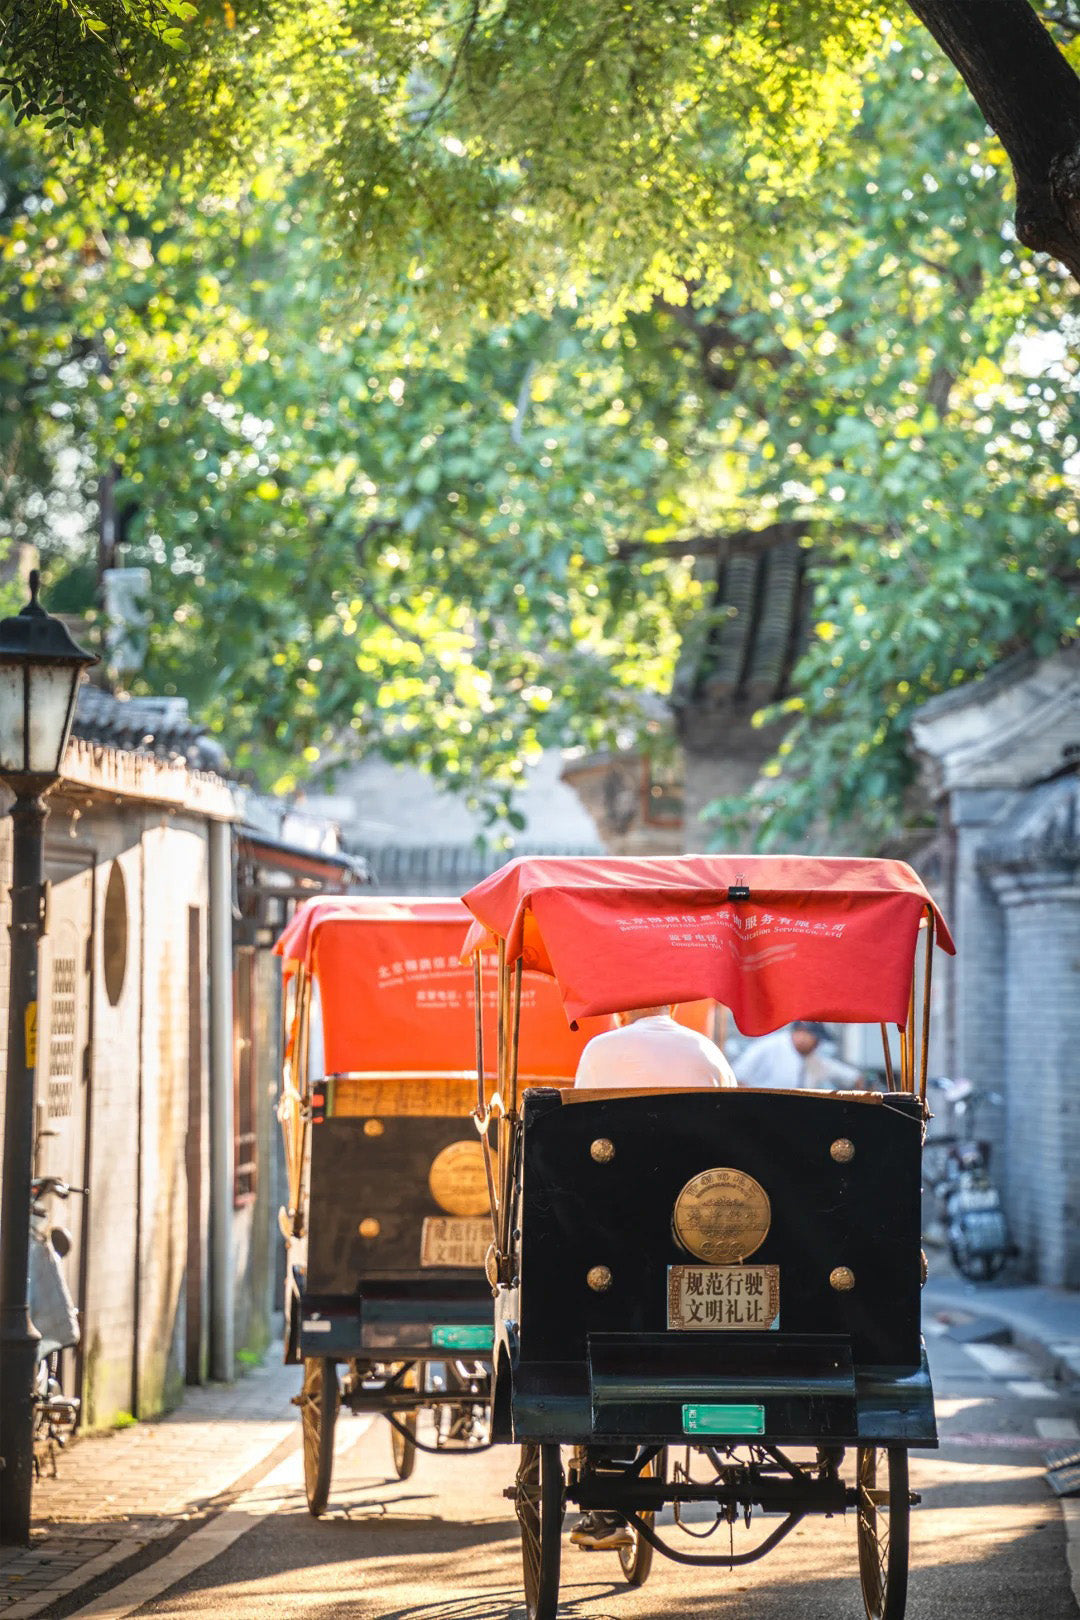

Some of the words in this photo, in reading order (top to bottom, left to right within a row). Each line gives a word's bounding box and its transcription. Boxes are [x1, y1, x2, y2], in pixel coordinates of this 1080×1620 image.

[686, 1272, 763, 1296] 规范行驶
[686, 1299, 763, 1323] 文明礼让
